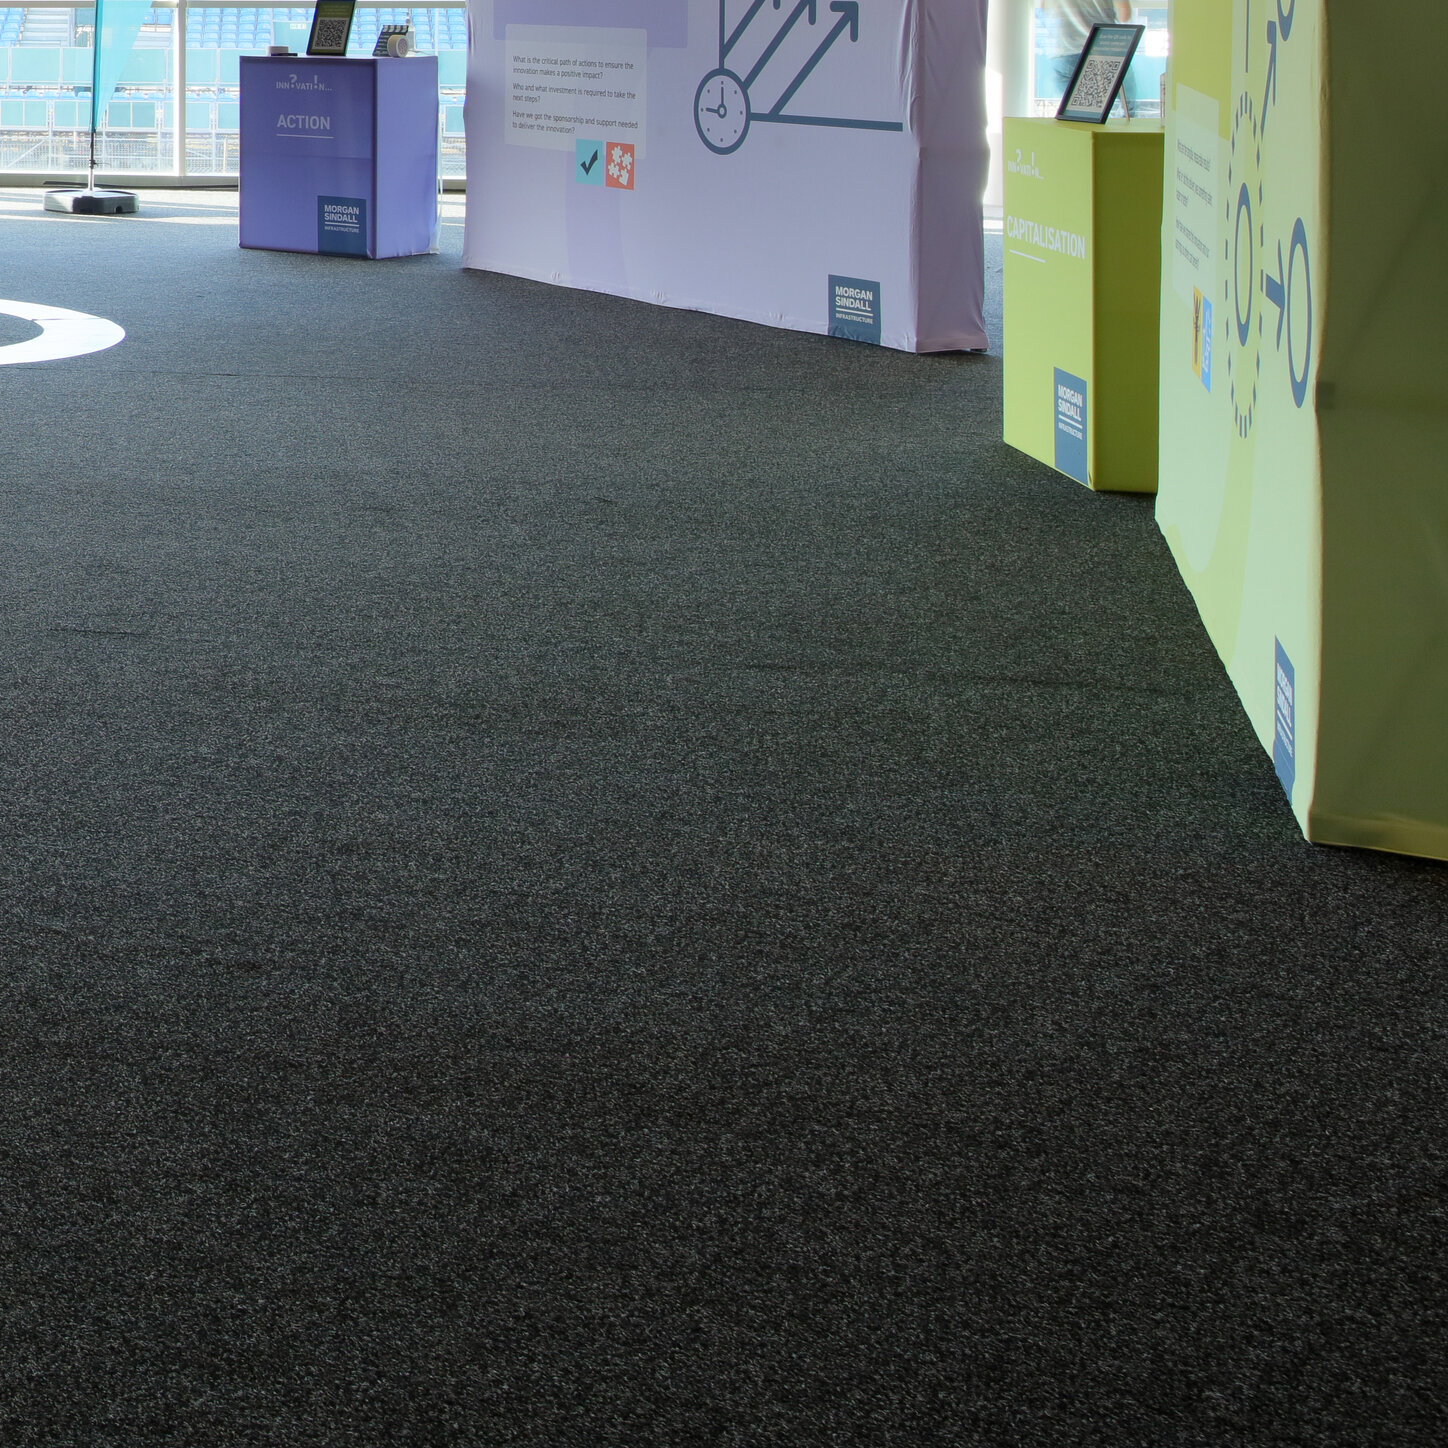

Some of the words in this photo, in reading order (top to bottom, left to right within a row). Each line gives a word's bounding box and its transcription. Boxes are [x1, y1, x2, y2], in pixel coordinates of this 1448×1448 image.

[527, 56, 531, 64] is
[542, 57, 558, 65] critical
[560, 58, 571, 66] path
[578, 59, 597, 68] actions
[625, 62, 634, 70] the
[513, 67, 538, 75] innovation
[561, 70, 581, 78] positive
[582, 72, 603, 80] impact?
[535, 84, 548, 92] what
[549, 86, 577, 95] investment
[584, 89, 606, 98] required
[525, 95, 541, 103] steps?
[276, 114, 331, 130] ACTION
[324, 204, 359, 215] MORGAN
[324, 213, 358, 223] SINDALL
[1007, 215, 1086, 260] CAPITALISATION
[836, 286, 872, 300] MORGAN
[836, 296, 871, 310] SINDALL
[1058, 384, 1083, 407] MORGAN
[1058, 399, 1081, 421] SINDALL
